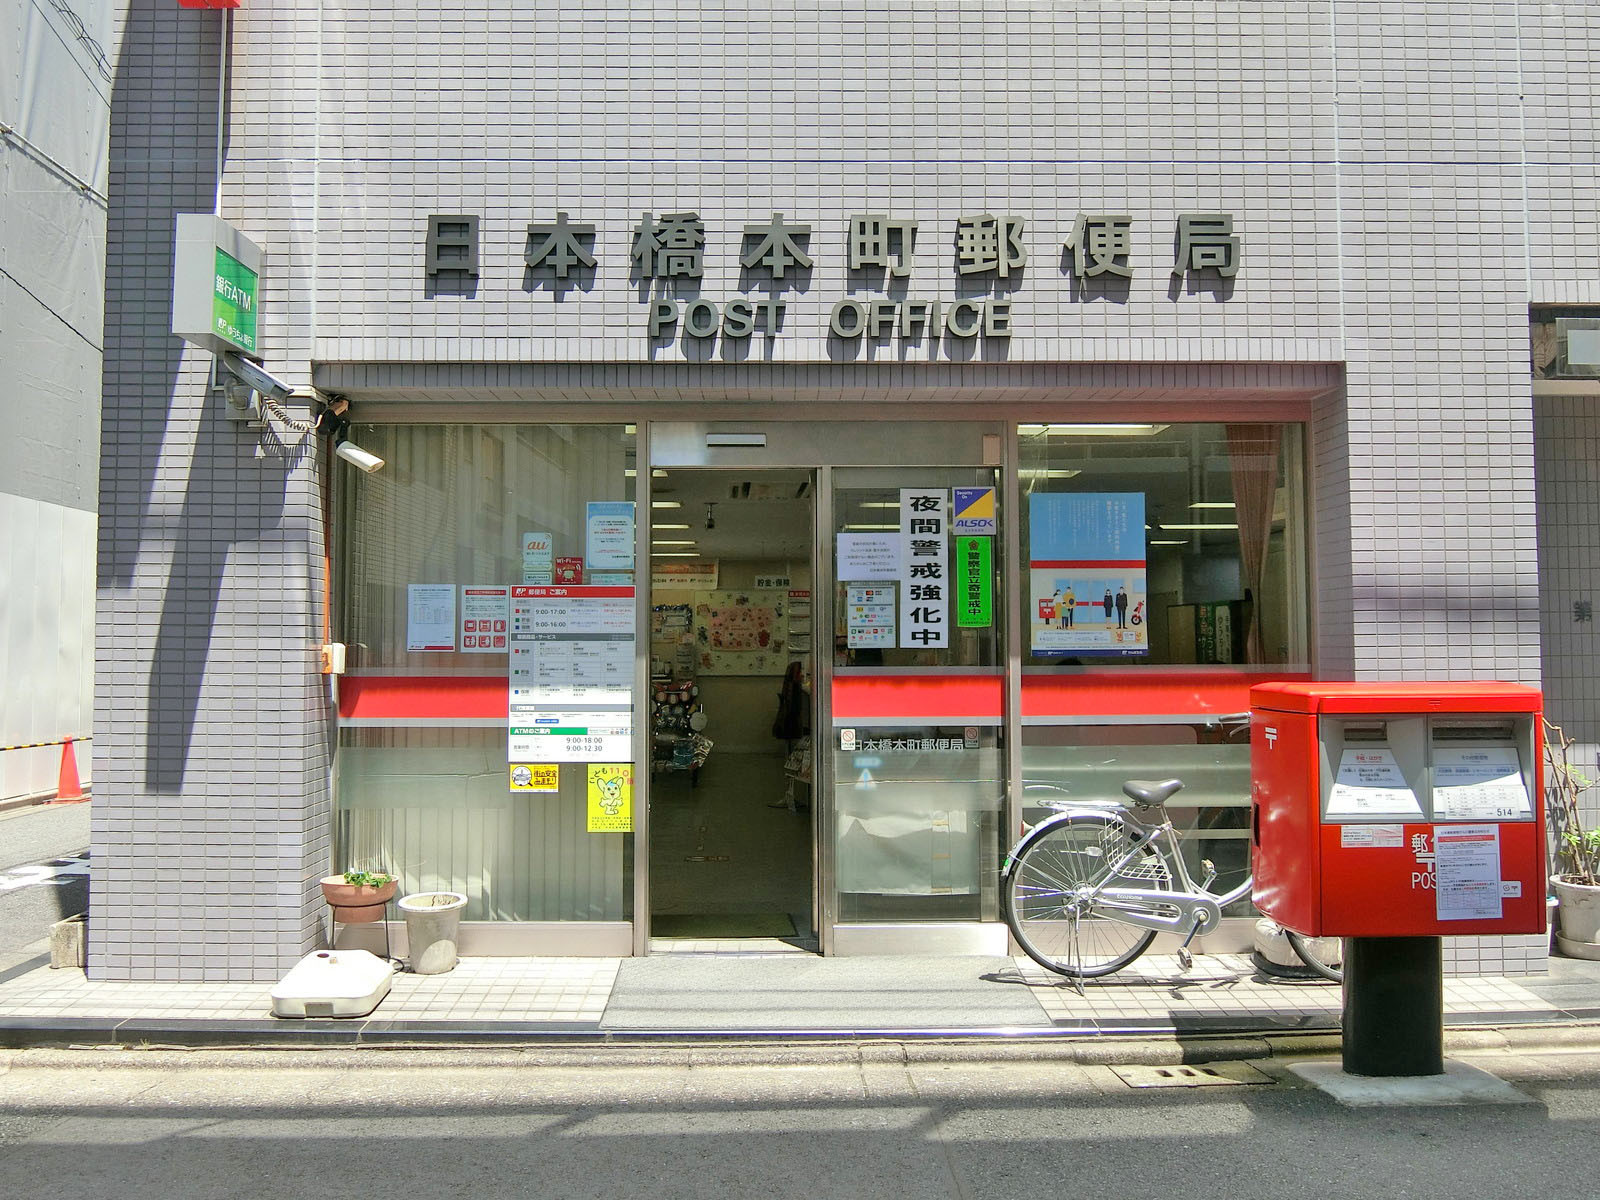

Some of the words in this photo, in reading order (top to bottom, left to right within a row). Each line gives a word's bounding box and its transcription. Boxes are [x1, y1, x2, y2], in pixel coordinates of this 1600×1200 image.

[427, 211, 1241, 278] 日本橋本町郵便局
[215, 274, 251, 312] 銀行ATM
[651, 299, 786, 337] POST
[830, 299, 1012, 337] OFFICE
[227, 325, 253, 348] ゆうちょ銀行
[955, 519, 994, 528] ALSOK
[527, 541, 549, 550] au
[909, 495, 943, 646] 夜間警戒強化中
[549, 588, 568, 596] ご案内
[855, 738, 964, 752] 日本橋本町郵便局
[1496, 808, 1512, 817] 514
[1411, 832, 1435, 853] 郵
